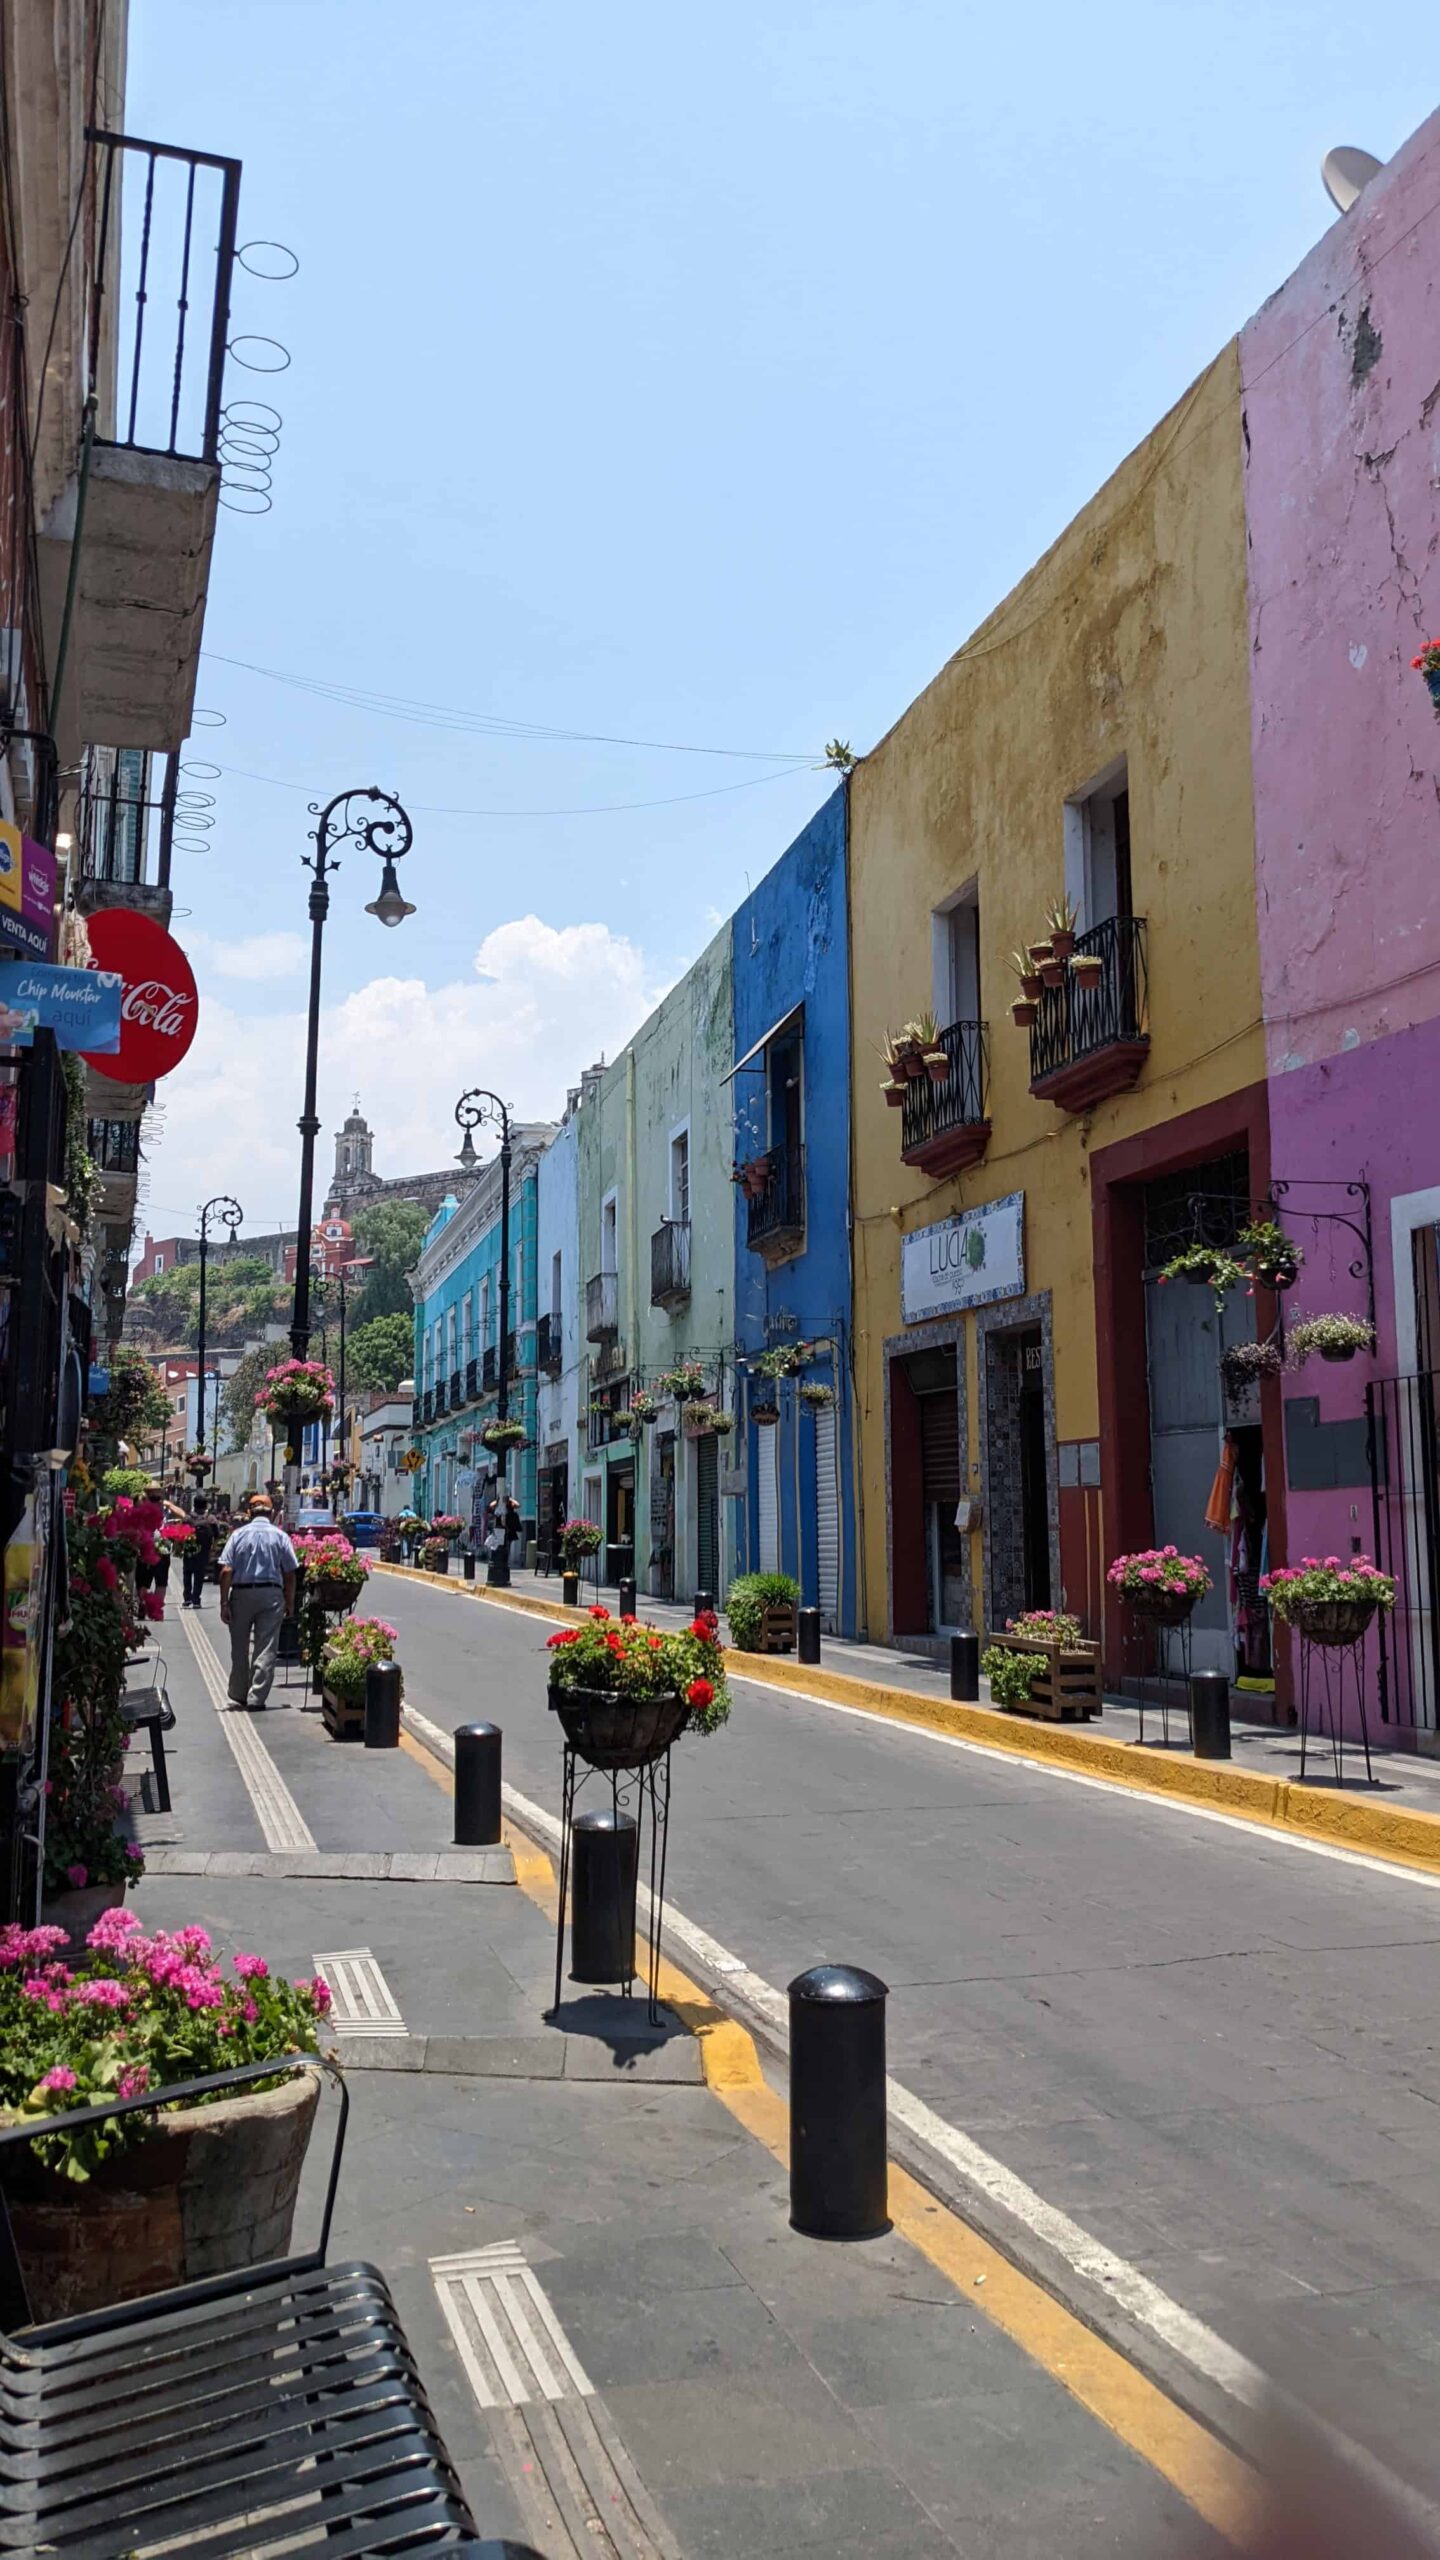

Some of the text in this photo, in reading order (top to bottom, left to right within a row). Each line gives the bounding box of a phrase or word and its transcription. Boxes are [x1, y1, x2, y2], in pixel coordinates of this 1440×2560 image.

[2, 914, 48, 953] VENTA AQUÍ
[17, 979, 102, 1005] Chip Movistar
[52, 1009, 92, 1028] aquí
